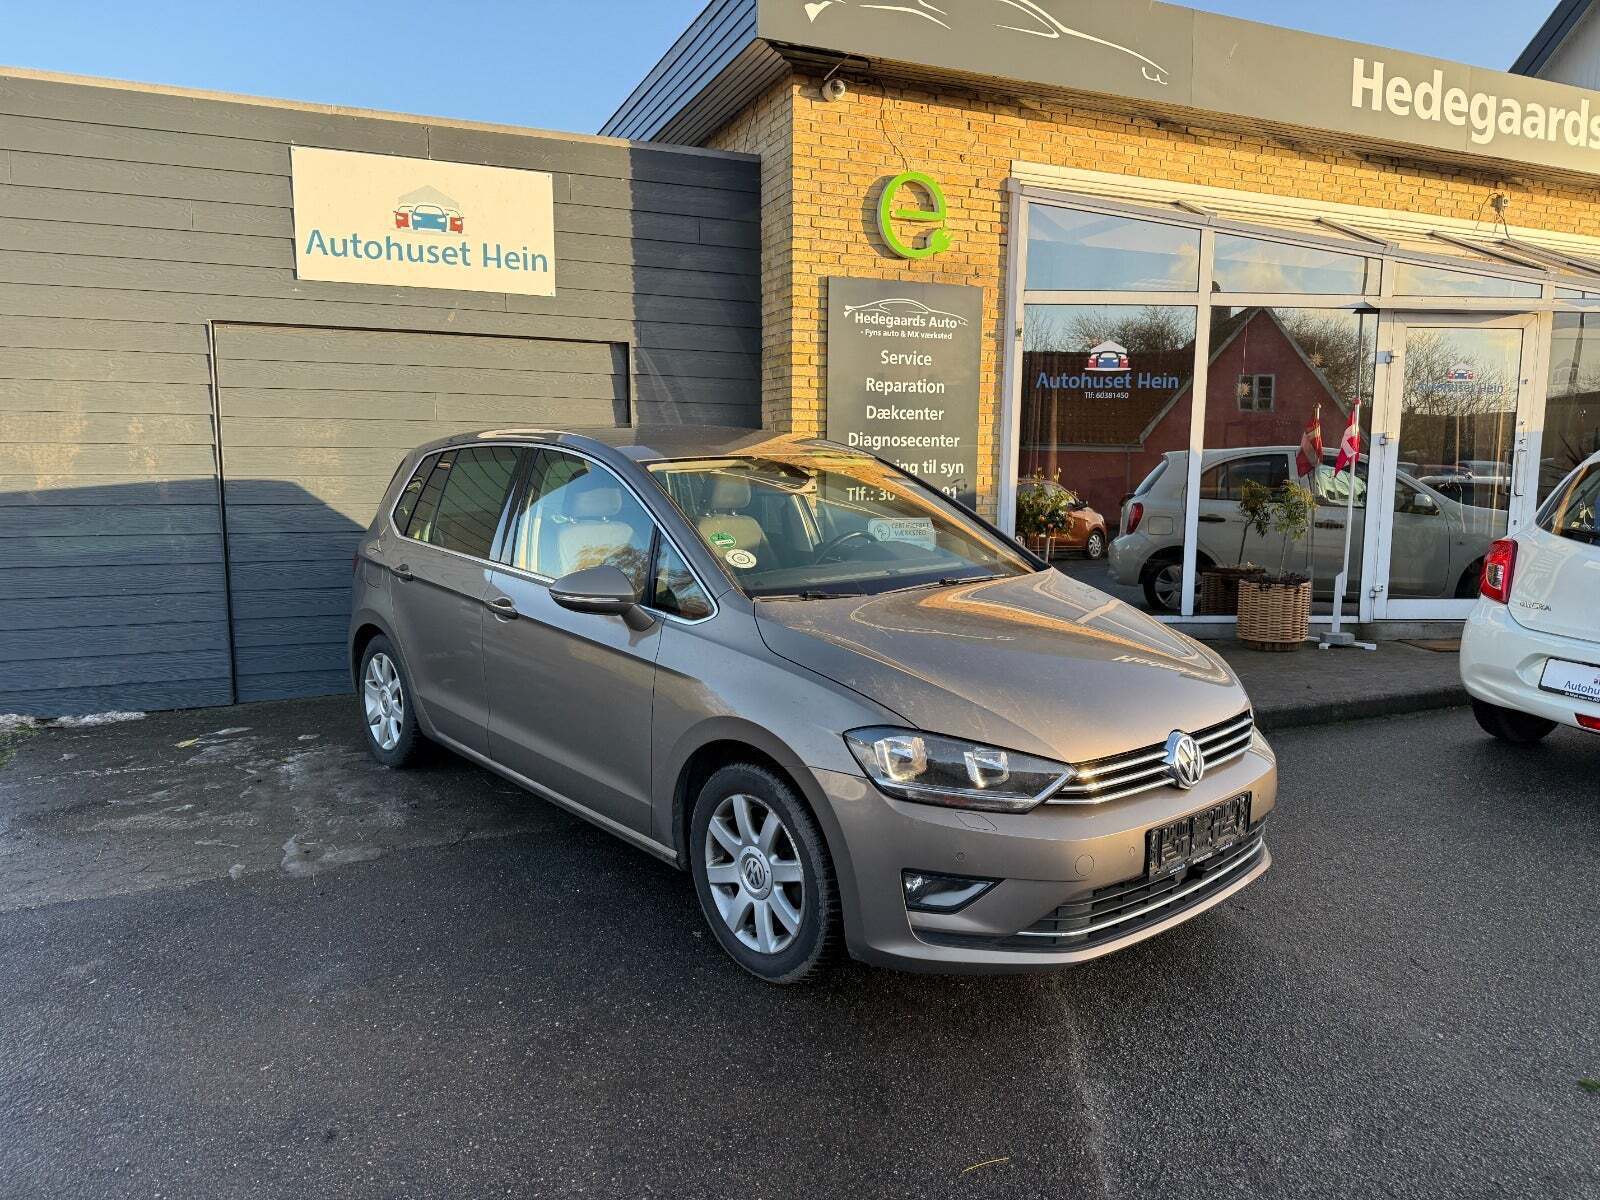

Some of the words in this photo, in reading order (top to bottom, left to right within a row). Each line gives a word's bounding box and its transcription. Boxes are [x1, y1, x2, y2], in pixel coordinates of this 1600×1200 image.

[305, 229, 471, 267] Autohuset
[482, 243, 548, 273] Hein
[854, 312, 926, 328] Hedegaards
[928, 316, 957, 329] Auto
[865, 329, 882, 338] Fyns
[900, 330, 906, 338] &
[920, 331, 953, 340] værksted
[880, 350, 932, 366] Service
[865, 377, 945, 396] Reparation
[1035, 371, 1132, 389] Autohuset
[1137, 372, 1179, 389] Hein
[1084, 391, 1095, 399] Tlf:
[866, 405, 945, 421] Dækcenter
[848, 432, 960, 450] Diagnosecenter
[923, 459, 937, 474] til
[940, 462, 964, 477] syn
[846, 487, 874, 501] Tlf.:
